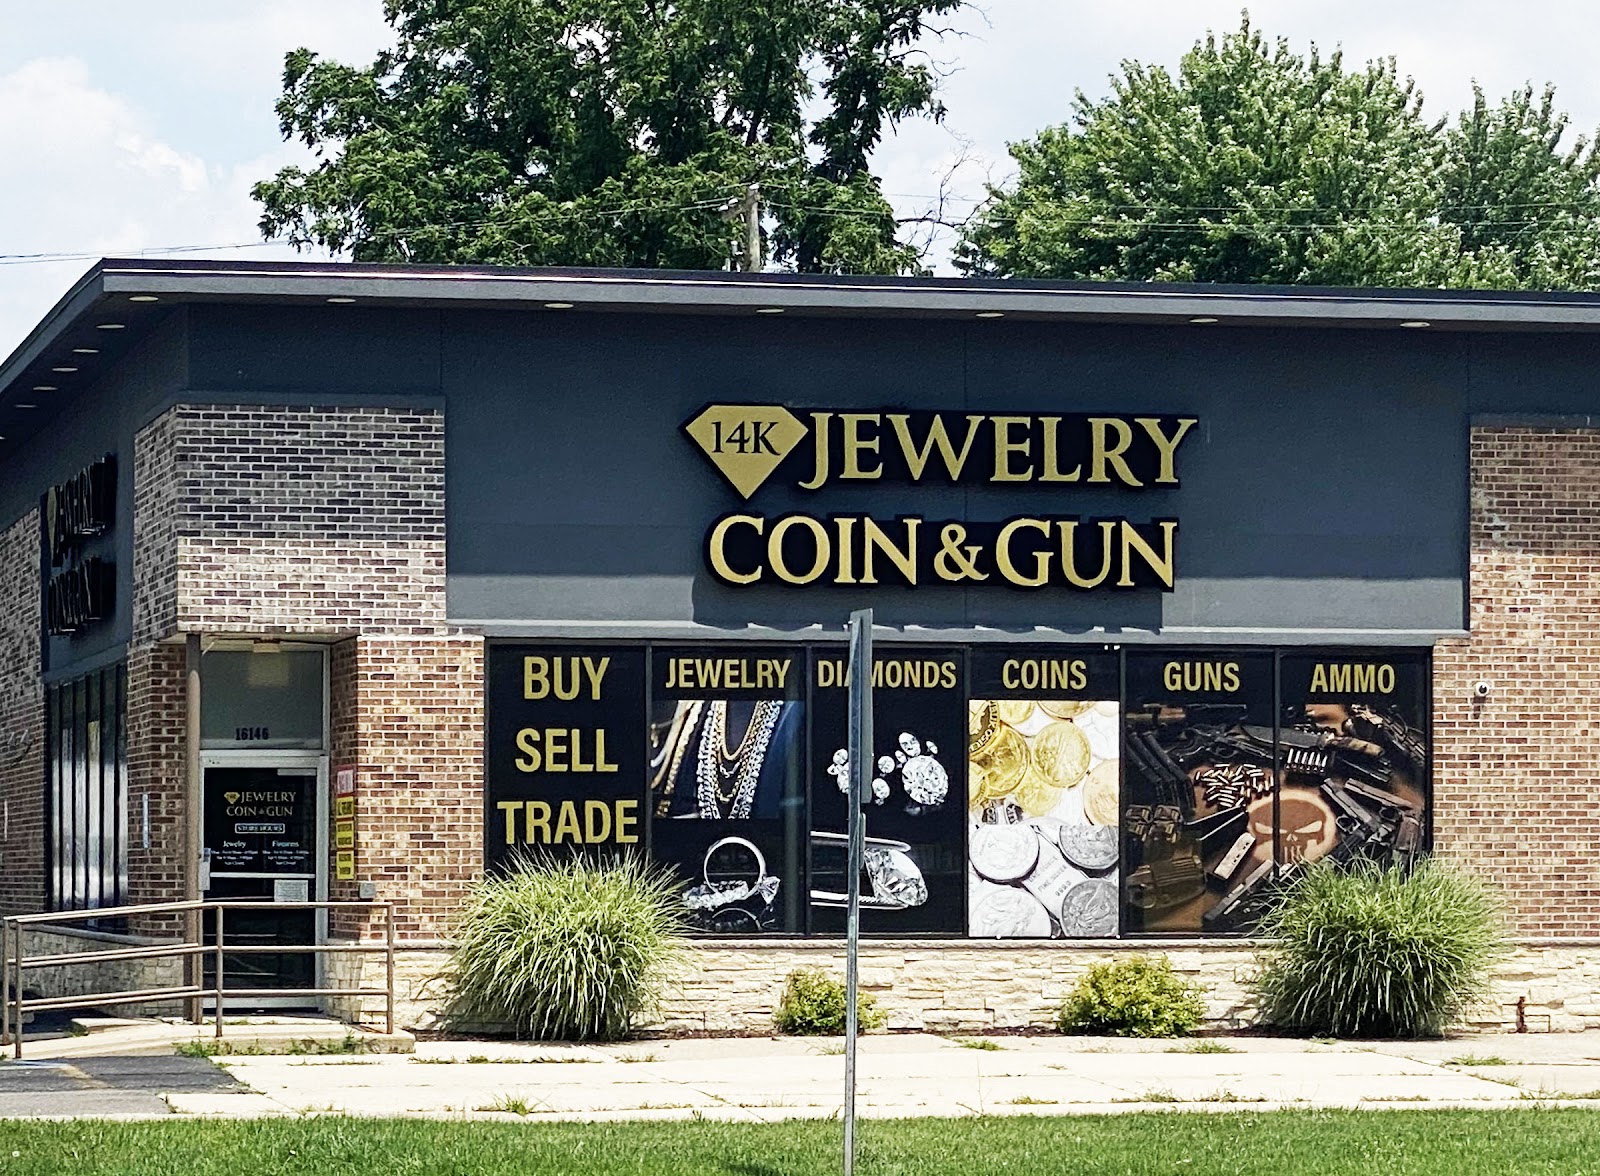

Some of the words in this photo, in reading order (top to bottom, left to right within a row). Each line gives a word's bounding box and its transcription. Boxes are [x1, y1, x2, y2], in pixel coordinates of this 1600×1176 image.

[711, 420, 782, 457] 14K
[798, 412, 1198, 490] JEWELRY
[709, 514, 922, 586] COIN
[933, 523, 990, 583] &
[995, 517, 1178, 588] GUN
[523, 656, 611, 701] BUY
[665, 658, 792, 690] JEWELRY
[1002, 658, 1088, 691] COINS
[1163, 661, 1241, 693] GUNS
[1309, 663, 1396, 694] AMMO
[235, 727, 269, 741] 16146
[515, 727, 619, 773] SELL
[226, 806, 257, 817] COIN
[266, 806, 294, 817] GUN
[240, 791, 297, 803] JEWELRY
[497, 799, 639, 845] TRADE
